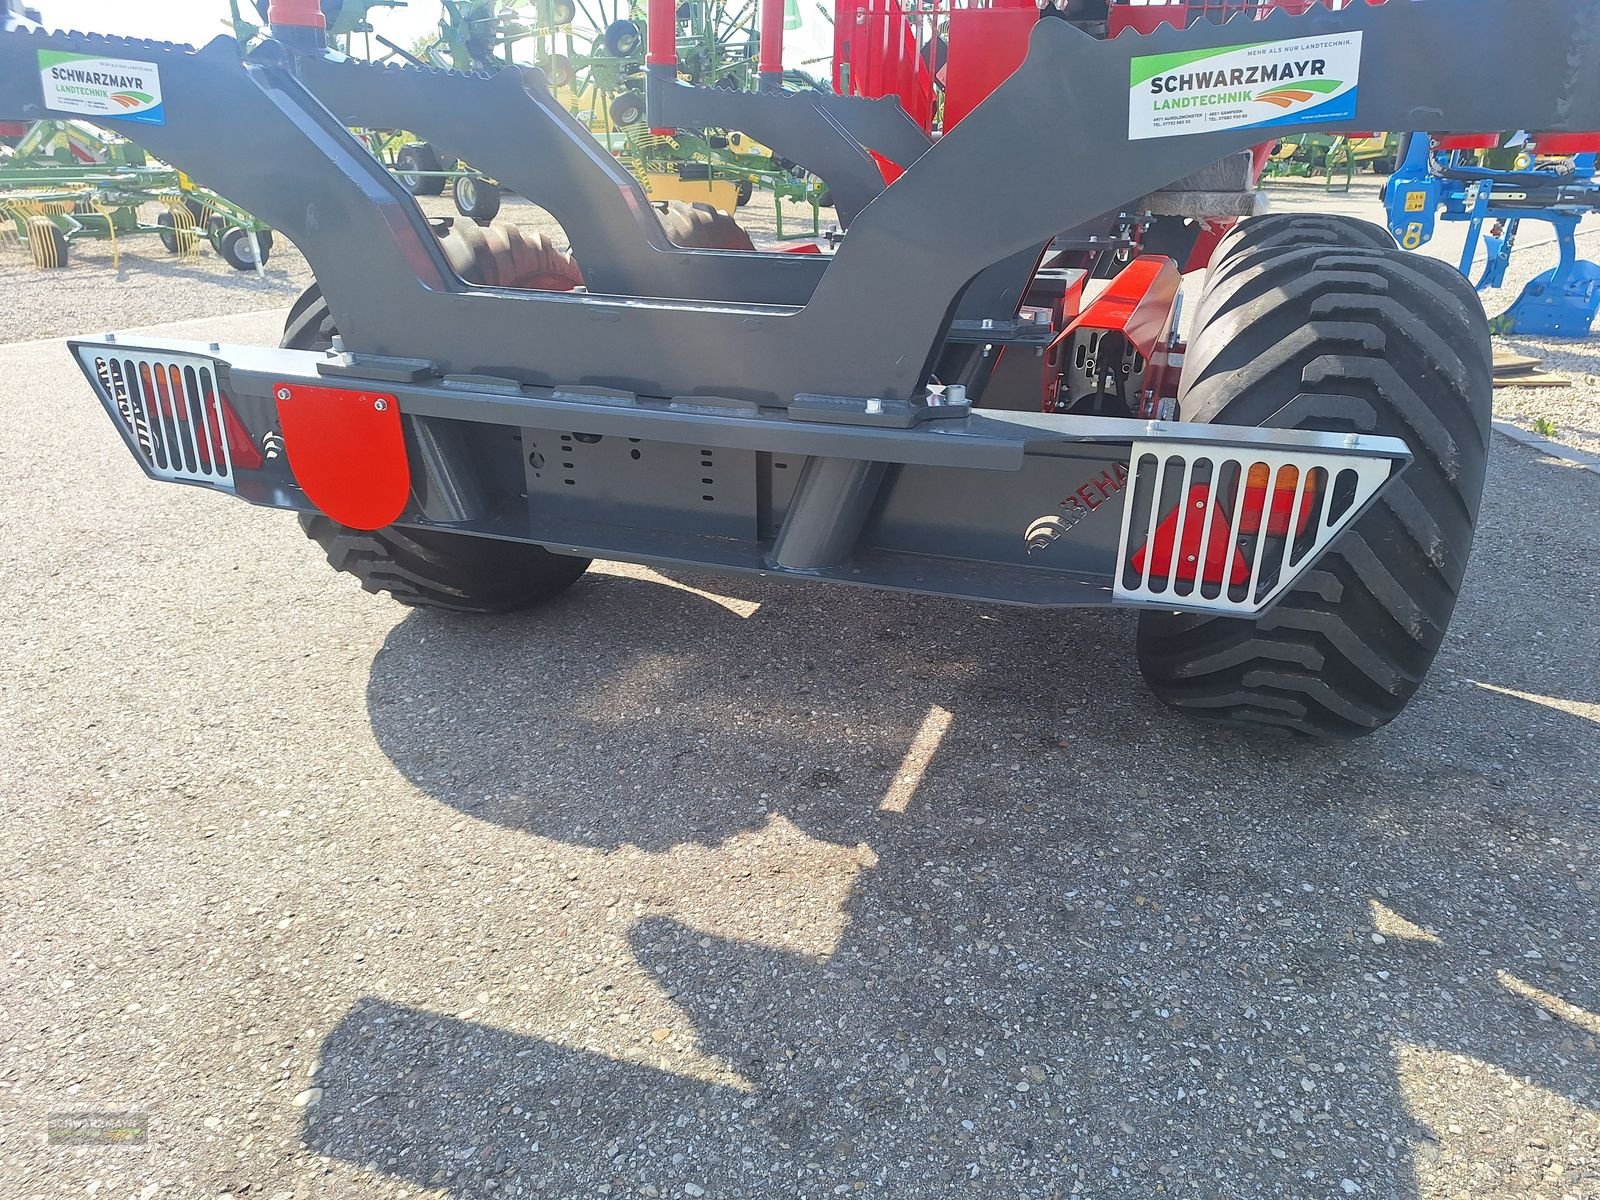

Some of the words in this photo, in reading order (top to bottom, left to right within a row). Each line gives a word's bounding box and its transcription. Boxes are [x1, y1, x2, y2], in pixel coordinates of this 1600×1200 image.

[1301, 40, 1352, 50] LANDTECHNIK.
[52, 68, 143, 90] SCHWARZMAYR
[1151, 59, 1325, 93] SCHWARZMAYR
[56, 84, 108, 98] LANDTECHNIK
[1154, 91, 1253, 110] LANDTECHNIK
